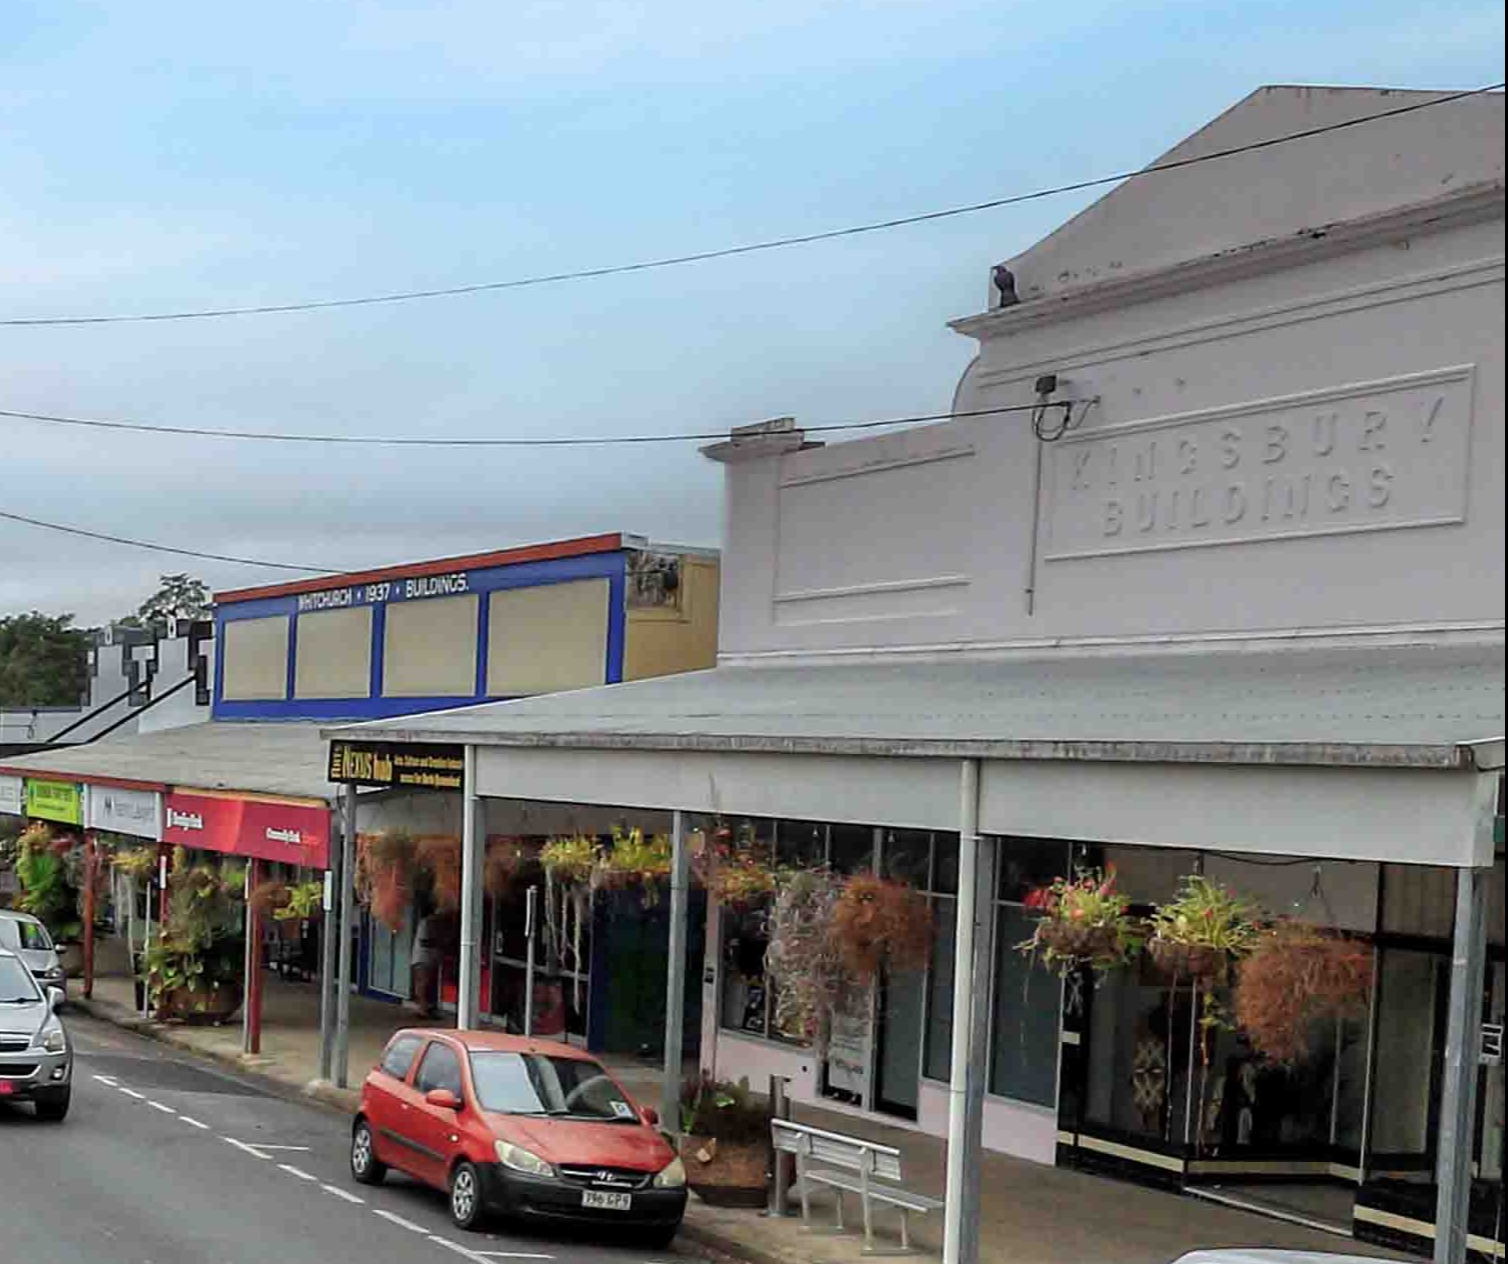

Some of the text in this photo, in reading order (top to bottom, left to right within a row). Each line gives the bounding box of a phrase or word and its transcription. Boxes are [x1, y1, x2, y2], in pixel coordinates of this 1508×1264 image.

[1070, 395, 1445, 492] KINGSBURY
[1102, 466, 1395, 538] BUILDINGS
[365, 583, 391, 602] 1937
